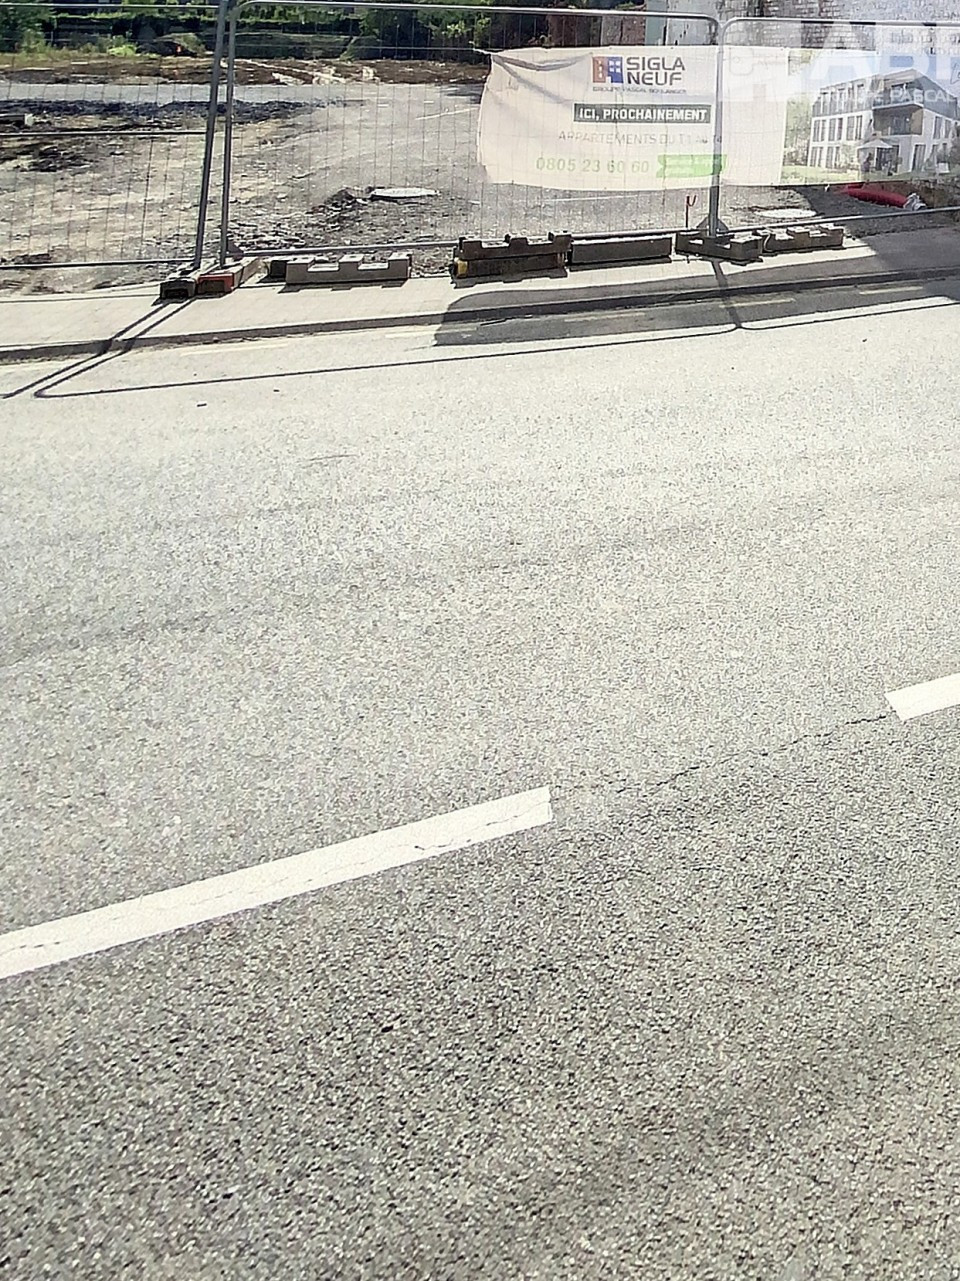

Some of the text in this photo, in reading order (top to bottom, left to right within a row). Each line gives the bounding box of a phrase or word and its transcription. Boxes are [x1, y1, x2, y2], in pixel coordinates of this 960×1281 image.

[626, 56, 686, 71] SIGLA
[627, 71, 682, 86] NEUF
[603, 107, 708, 121] PROCHAINEMENT
[558, 130, 657, 145] APPARTEMENTS
[536, 157, 576, 171] 0805
[582, 159, 600, 172] 23
[606, 160, 625, 173] 60
[631, 160, 649, 174] 60
